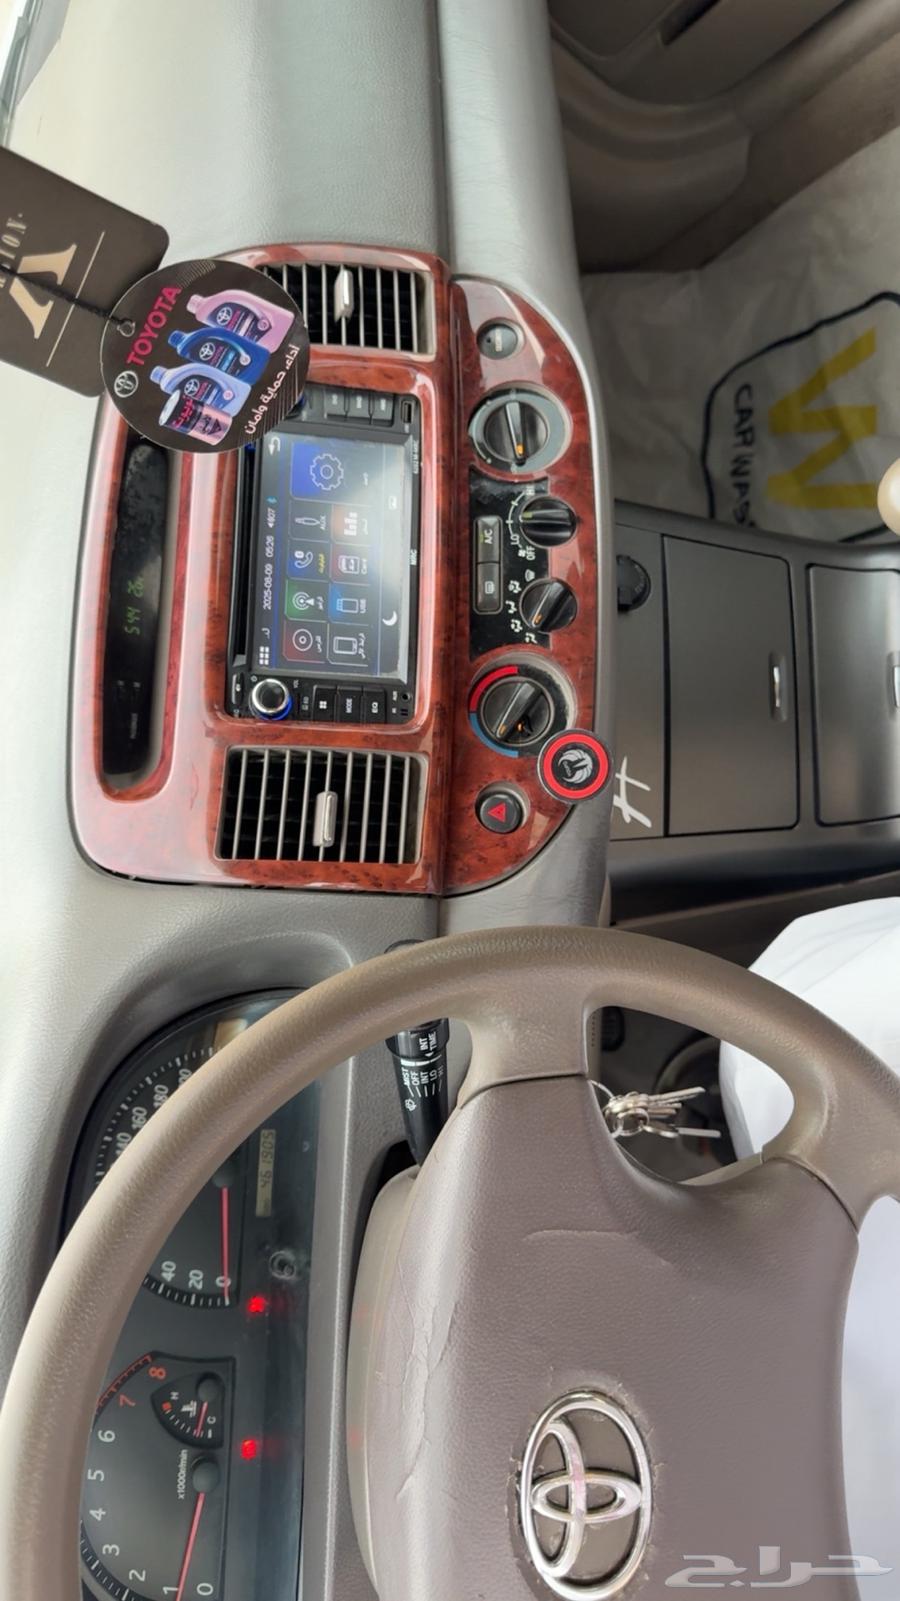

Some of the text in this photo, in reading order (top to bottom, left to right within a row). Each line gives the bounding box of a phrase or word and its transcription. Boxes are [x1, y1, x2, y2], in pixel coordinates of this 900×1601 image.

[126, 287, 182, 365] TOYOTA
[260, 371, 286, 403] حماية
[243, 405, 268, 434] وأمان
[731, 384, 755, 527] CAR WAS
[482, 529, 493, 544] A/C
[510, 533, 520, 545] LO
[525, 546, 536, 561] OFF
[262, 563, 273, 610] 2025-08-09
[345, 698, 353, 714] MODE
[371, 701, 379, 714] EQ
[419, 1037, 428, 1050] INT
[428, 1032, 437, 1051] TIME
[401, 1067, 410, 1086] MIST
[411, 1071, 420, 1086] OFF
[420, 1071, 429, 1084] INT
[430, 1069, 438, 1081] LO
[132, 1106, 148, 1130] 160
[161, 1260, 176, 1282] 40
[189, 1269, 203, 1289] 20
[216, 1275, 231, 1288] 0
[148, 1366, 167, 1379] 8
[119, 1394, 136, 1407] 7
[170, 1391, 179, 1400] H
[206, 1415, 216, 1424] C
[98, 1429, 116, 1443] 6
[87, 1469, 105, 1482] 5
[176, 1449, 189, 1500] x1000r/min
[89, 1508, 107, 1521] 4
[102, 1544, 120, 1556] 3
[128, 1569, 146, 1582] 2
[162, 1586, 179, 1595] 1
[196, 1582, 214, 1596] 0
